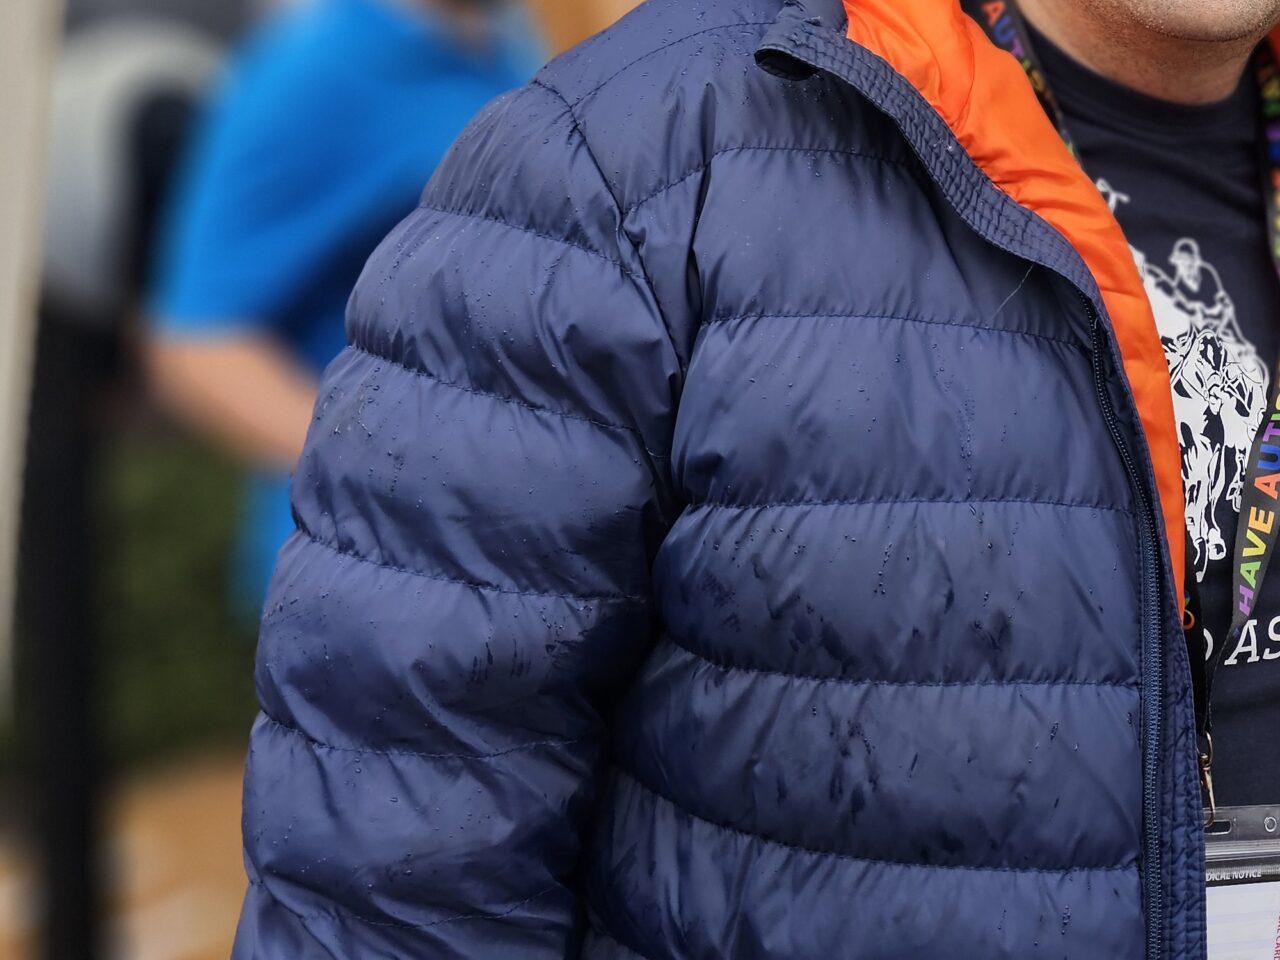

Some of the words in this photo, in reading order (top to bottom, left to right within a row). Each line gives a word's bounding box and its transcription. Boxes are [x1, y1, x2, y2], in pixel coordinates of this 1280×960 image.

[1238, 506, 1275, 617] HAVE
[1206, 871, 1231, 881] DICAL
[1232, 869, 1262, 880] NOTICE
